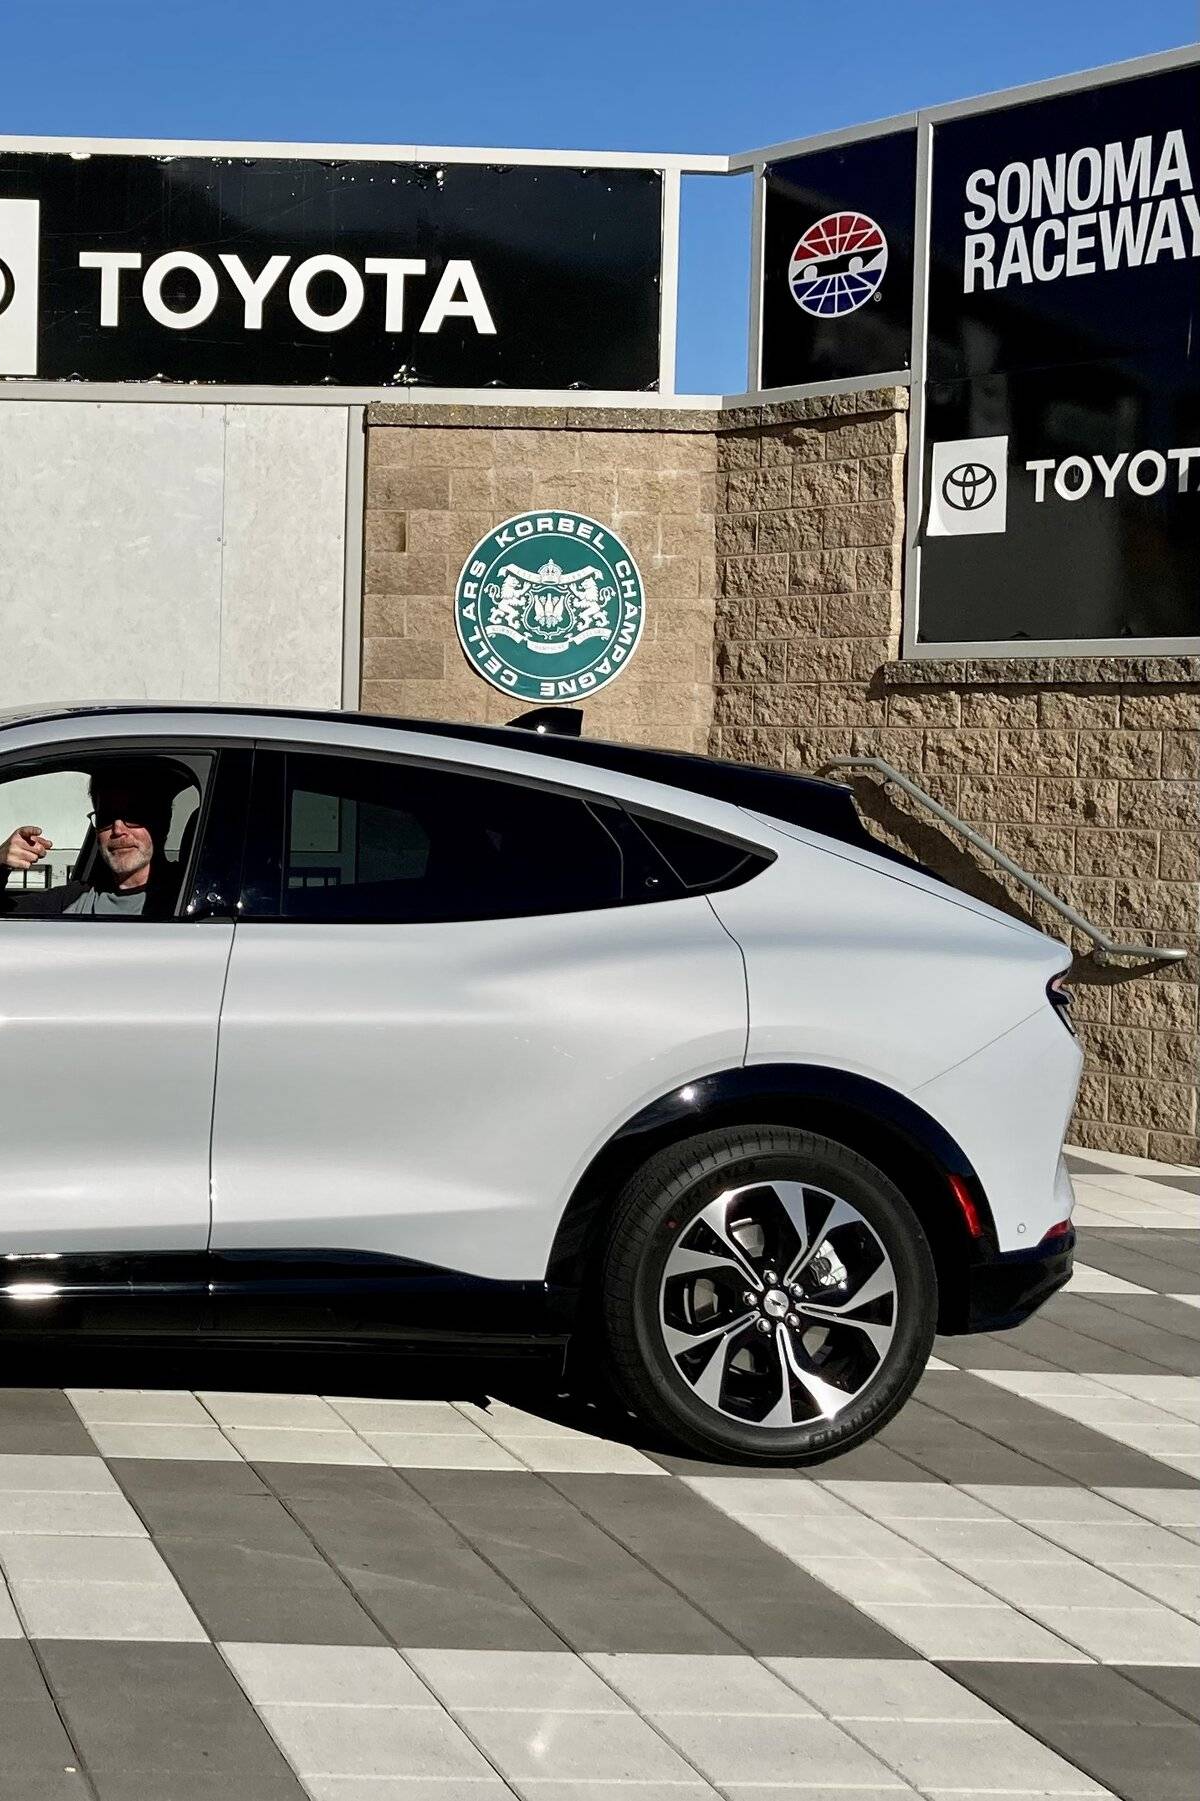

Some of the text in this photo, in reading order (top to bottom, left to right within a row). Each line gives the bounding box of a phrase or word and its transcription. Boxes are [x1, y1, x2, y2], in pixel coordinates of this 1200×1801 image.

[963, 128, 1194, 231] SONOMA
[78, 249, 498, 336] TOYOTA
[1025, 446, 1200, 503] TOYOT
[462, 517, 639, 697] KORBEL CHAMPAGNE CELLARS
